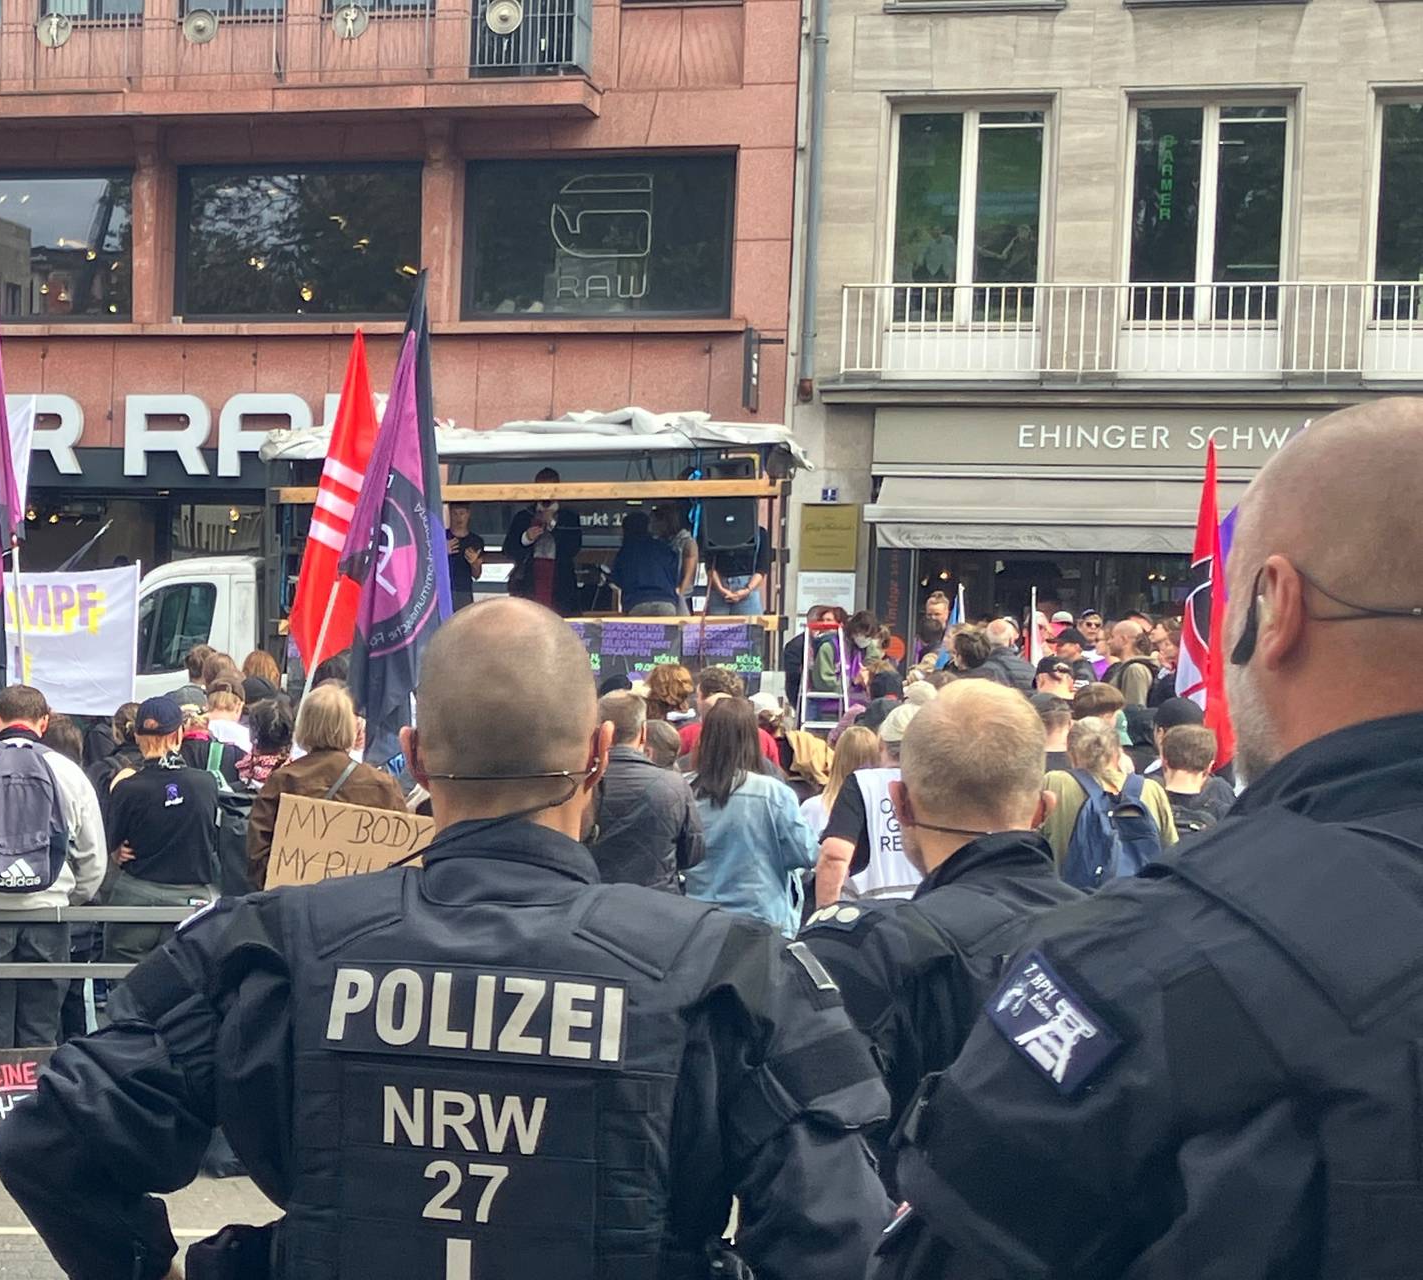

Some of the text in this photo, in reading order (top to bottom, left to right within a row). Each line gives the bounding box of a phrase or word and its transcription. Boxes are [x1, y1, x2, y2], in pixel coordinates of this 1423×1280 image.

[1159, 134, 1175, 220] BARMER
[557, 275, 647, 298] RAW
[124, 393, 347, 477] RA
[1018, 424, 1170, 449] EHINGER
[5, 584, 99, 629] MPF
[285, 803, 434, 851] MY BODY
[276, 846, 320, 880] MY
[327, 968, 624, 1062] POLIZEI
[383, 1086, 547, 1155] NRW
[422, 1160, 510, 1223] 27
